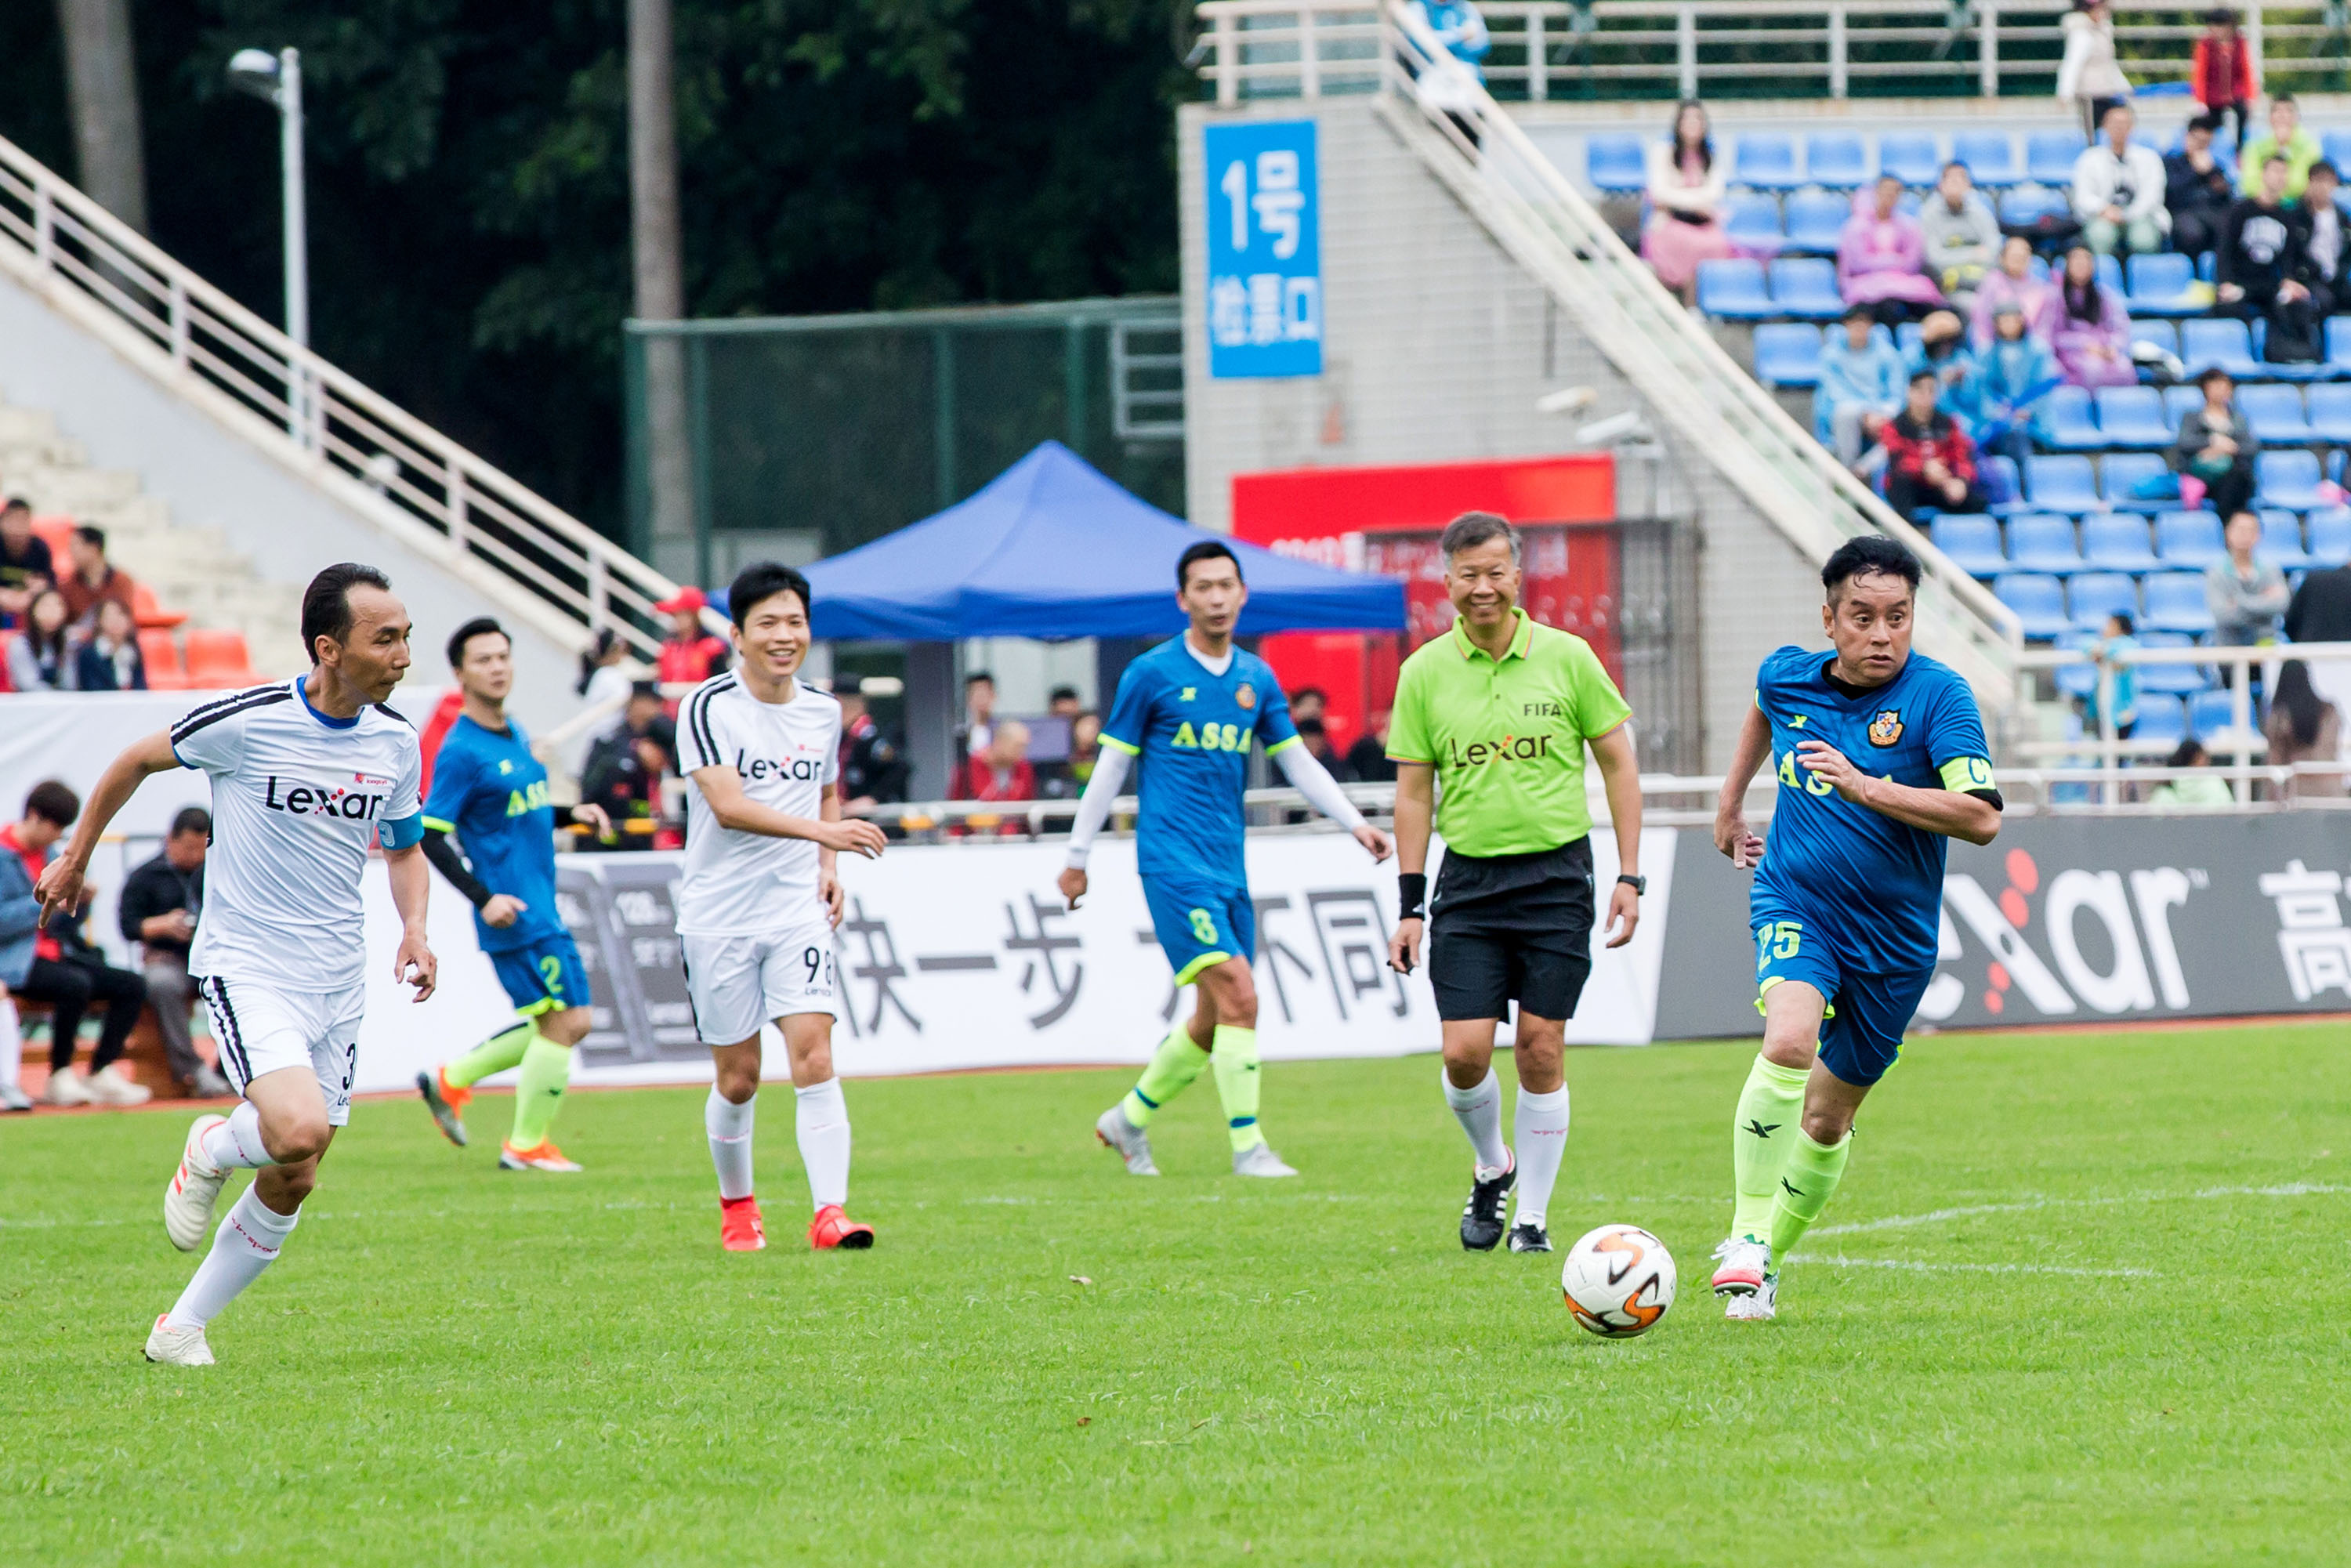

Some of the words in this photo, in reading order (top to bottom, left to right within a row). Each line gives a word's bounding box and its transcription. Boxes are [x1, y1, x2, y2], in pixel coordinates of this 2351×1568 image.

[1221, 150, 1306, 259] 1号
[1523, 703, 1561, 716] FIFA
[737, 748, 821, 780] Lexar
[1451, 734, 1552, 768] Lexar
[1968, 757, 1986, 784] C
[266, 775, 383, 820] Lexar
[1188, 907, 1219, 946] 8
[2258, 858, 2351, 1003] 高
[539, 955, 563, 994] 2
[834, 894, 1083, 1037] 快一步
[1137, 890, 1407, 1023] 不同
